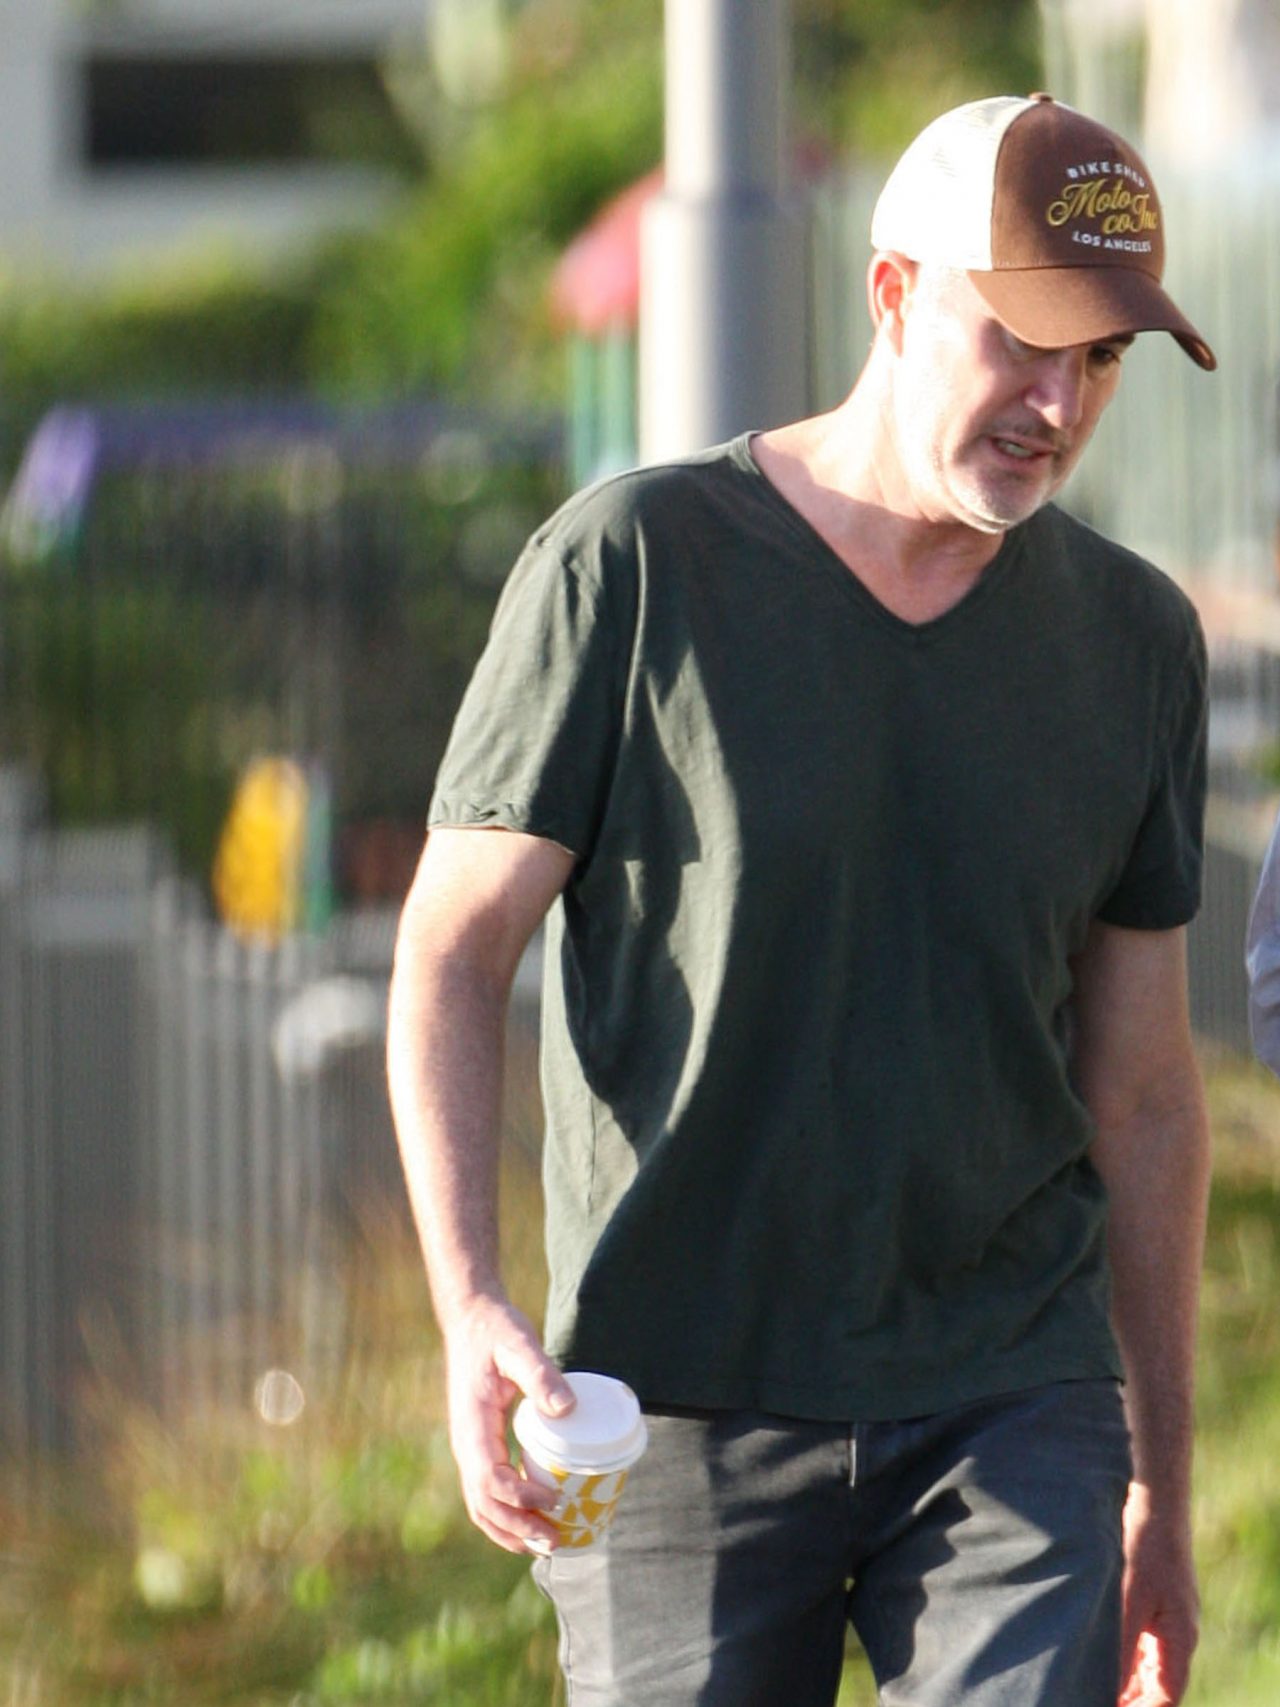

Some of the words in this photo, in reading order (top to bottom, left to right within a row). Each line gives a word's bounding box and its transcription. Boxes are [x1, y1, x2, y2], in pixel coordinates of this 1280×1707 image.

[1066, 161, 1111, 179] BIKE
[1046, 178, 1131, 227] Moto
[1072, 231, 1101, 247] LOS
[1104, 239, 1151, 252] ANGELES
